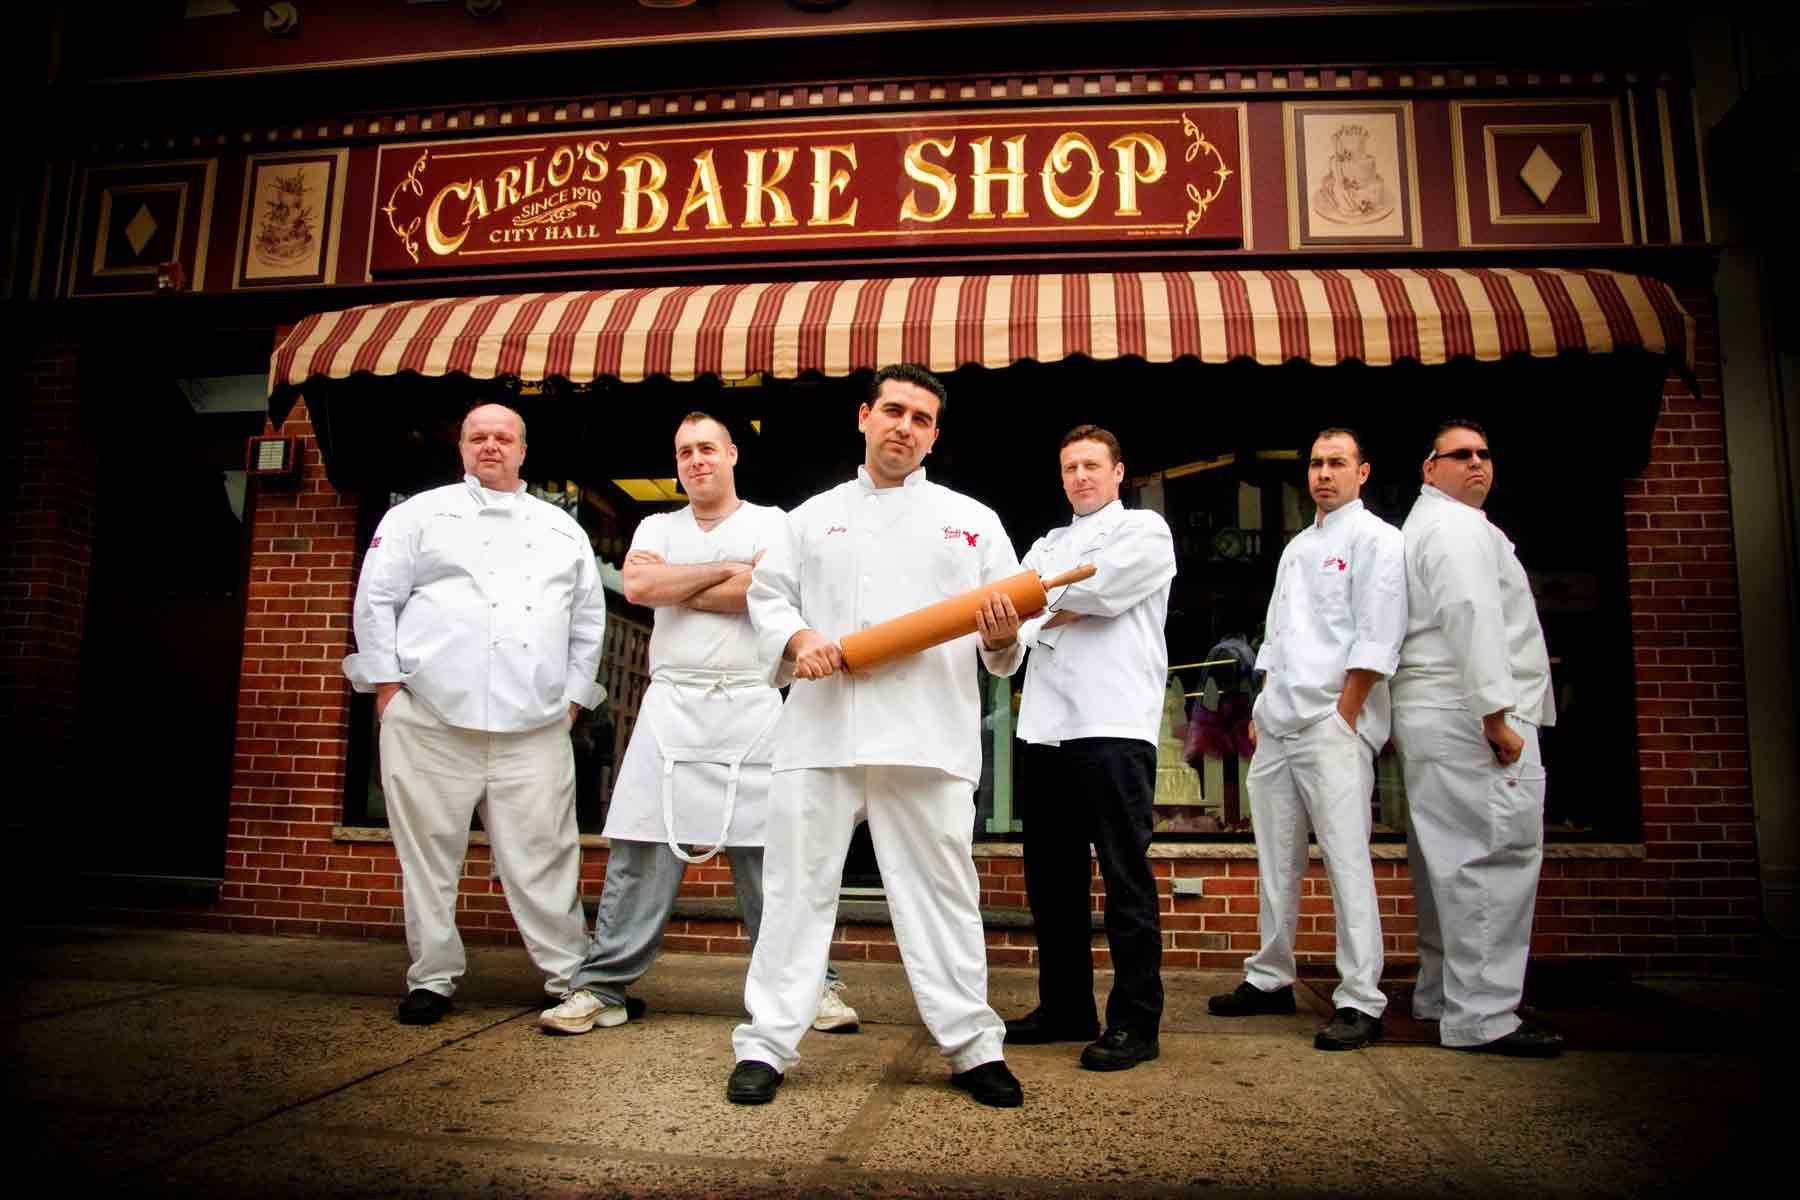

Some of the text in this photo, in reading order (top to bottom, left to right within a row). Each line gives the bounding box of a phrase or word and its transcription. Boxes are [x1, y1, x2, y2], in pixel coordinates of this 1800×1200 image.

[425, 131, 1168, 256] CARLO'S BAKE SHOP
[521, 186, 602, 218] SINCE 1910
[489, 224, 600, 243] CITY HALL
